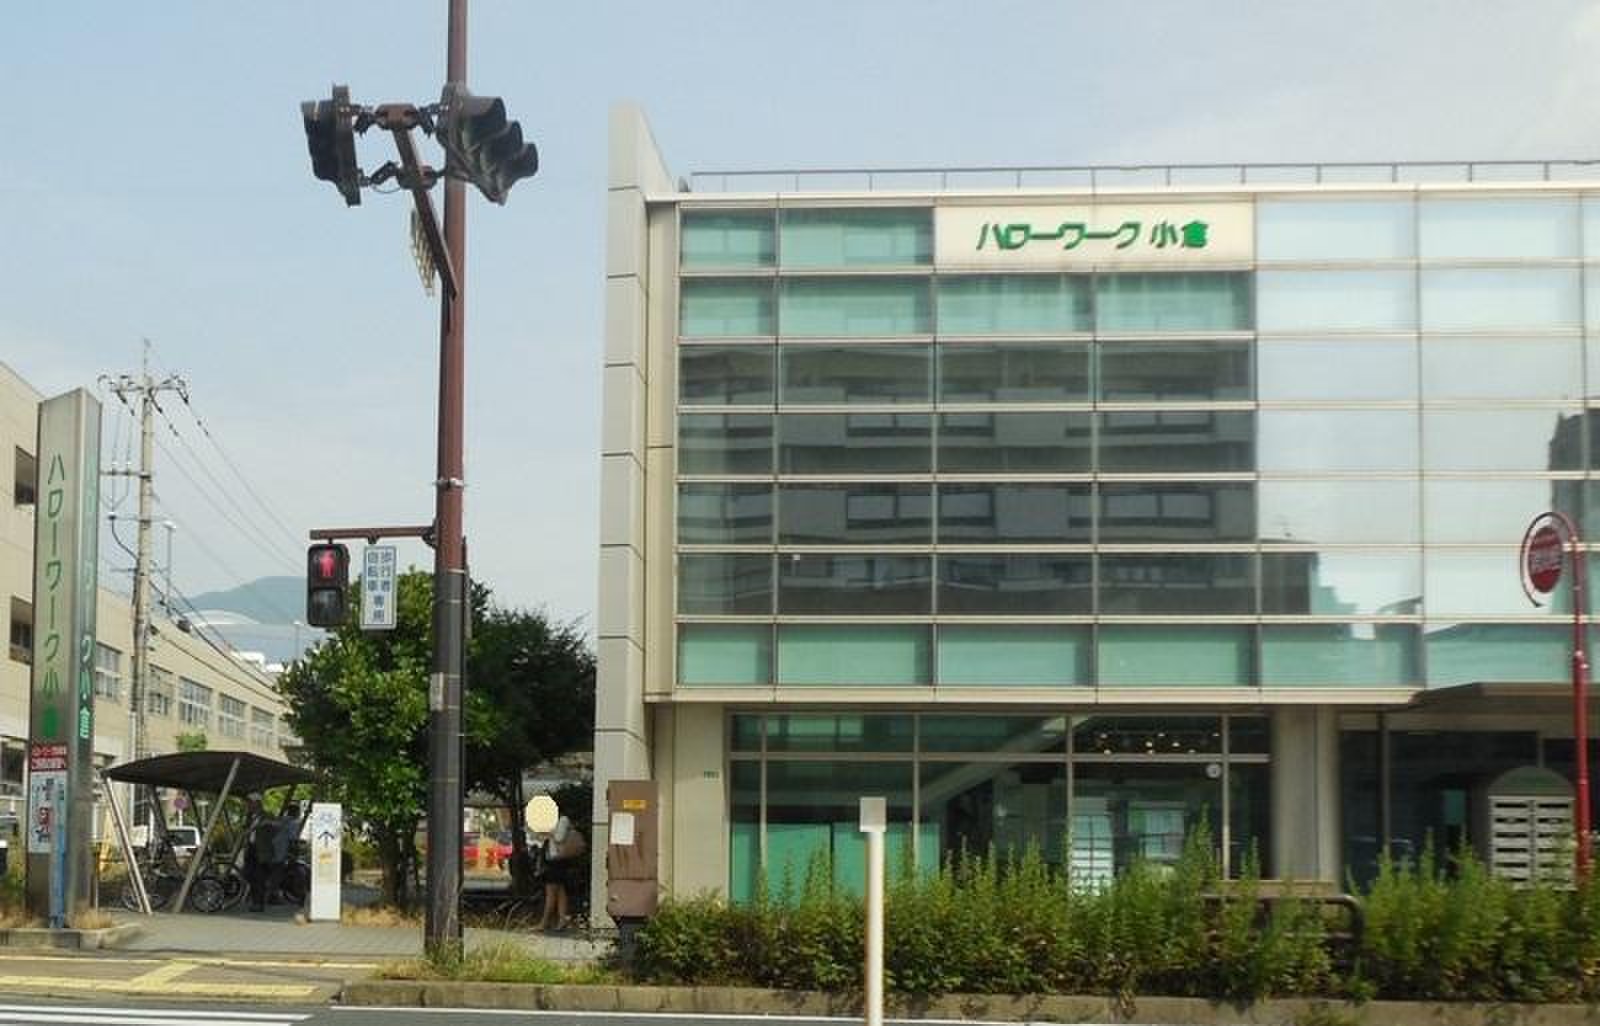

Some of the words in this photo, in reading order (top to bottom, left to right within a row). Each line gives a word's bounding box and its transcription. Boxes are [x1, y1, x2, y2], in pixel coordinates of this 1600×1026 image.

[43, 453, 65, 738] ハローワーク小
